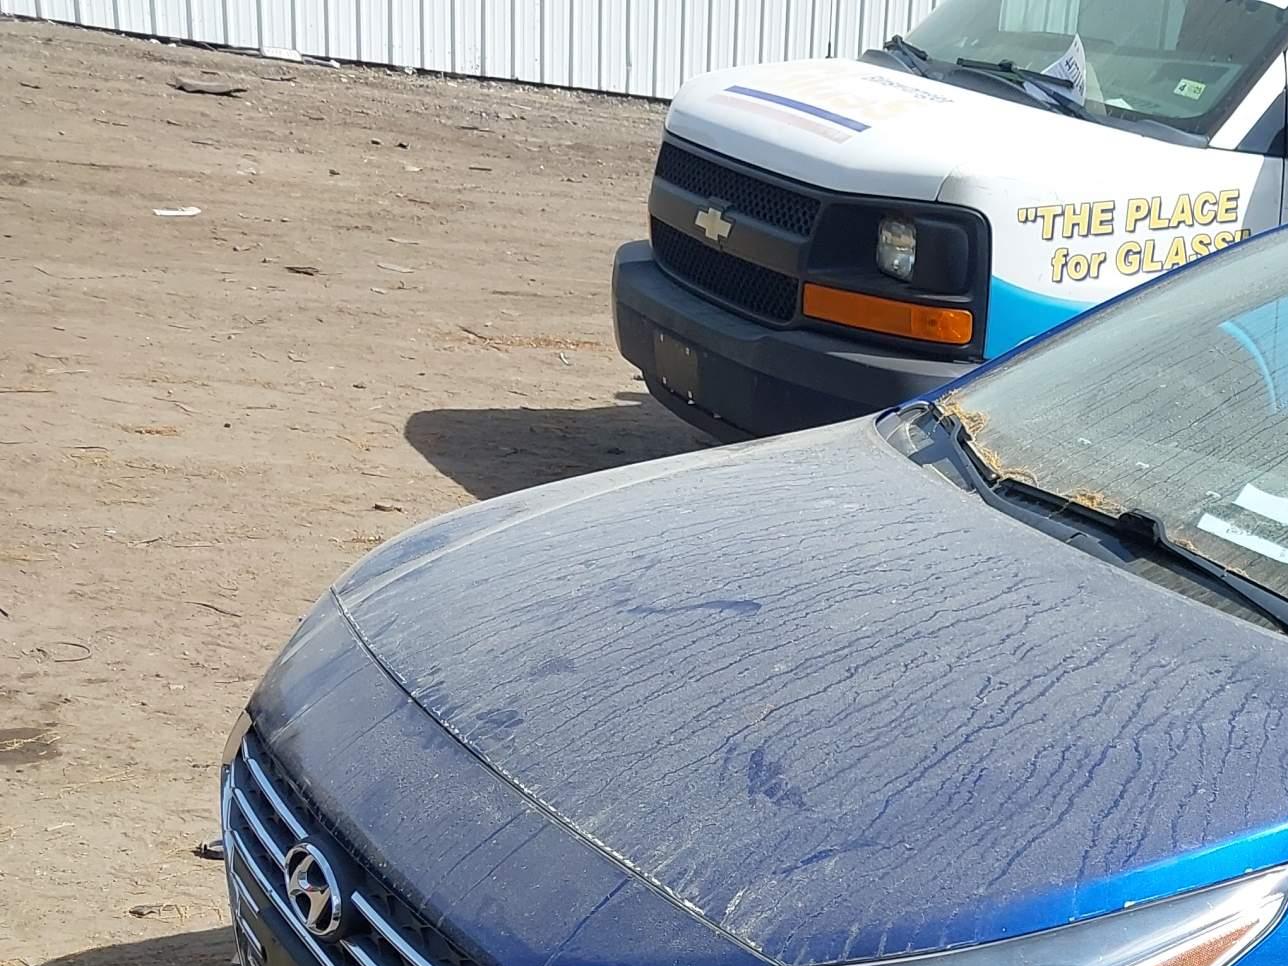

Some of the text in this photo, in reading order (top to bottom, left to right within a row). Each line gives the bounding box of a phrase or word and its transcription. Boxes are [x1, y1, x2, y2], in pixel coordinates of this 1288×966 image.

[1017, 189, 1240, 240] "THE PLACE
[1051, 247, 1107, 282] for
